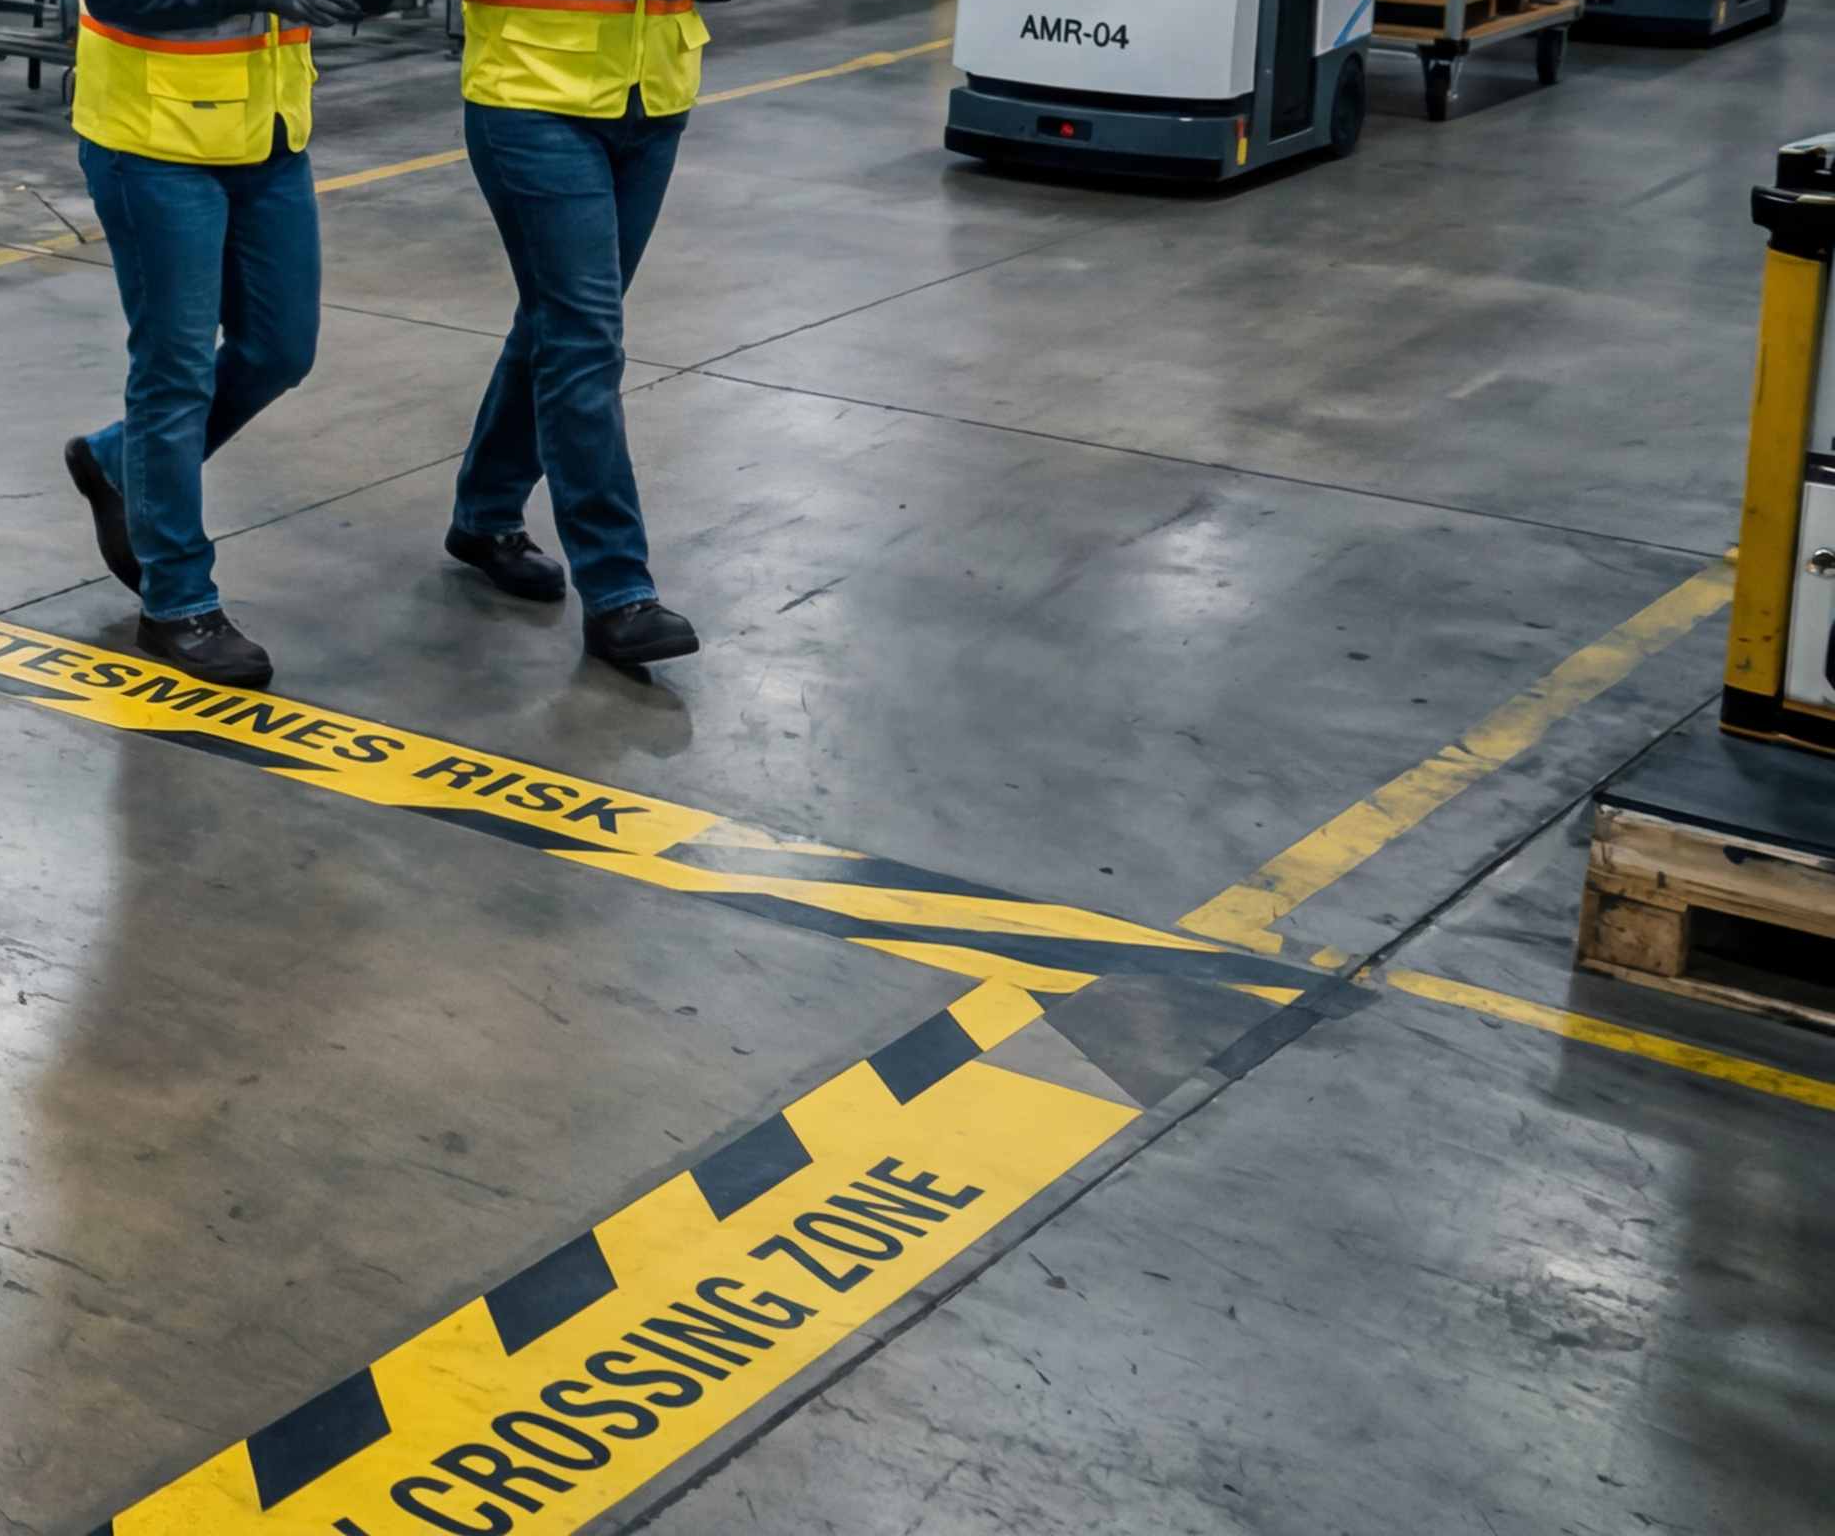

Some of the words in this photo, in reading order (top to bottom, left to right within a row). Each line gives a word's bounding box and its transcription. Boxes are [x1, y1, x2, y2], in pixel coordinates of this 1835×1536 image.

[1020, 14, 1130, 50] AMR-04
[412, 756, 650, 835] RISK
[391, 1278, 817, 1536] CROSSING
[748, 1156, 984, 1292] ZONE
